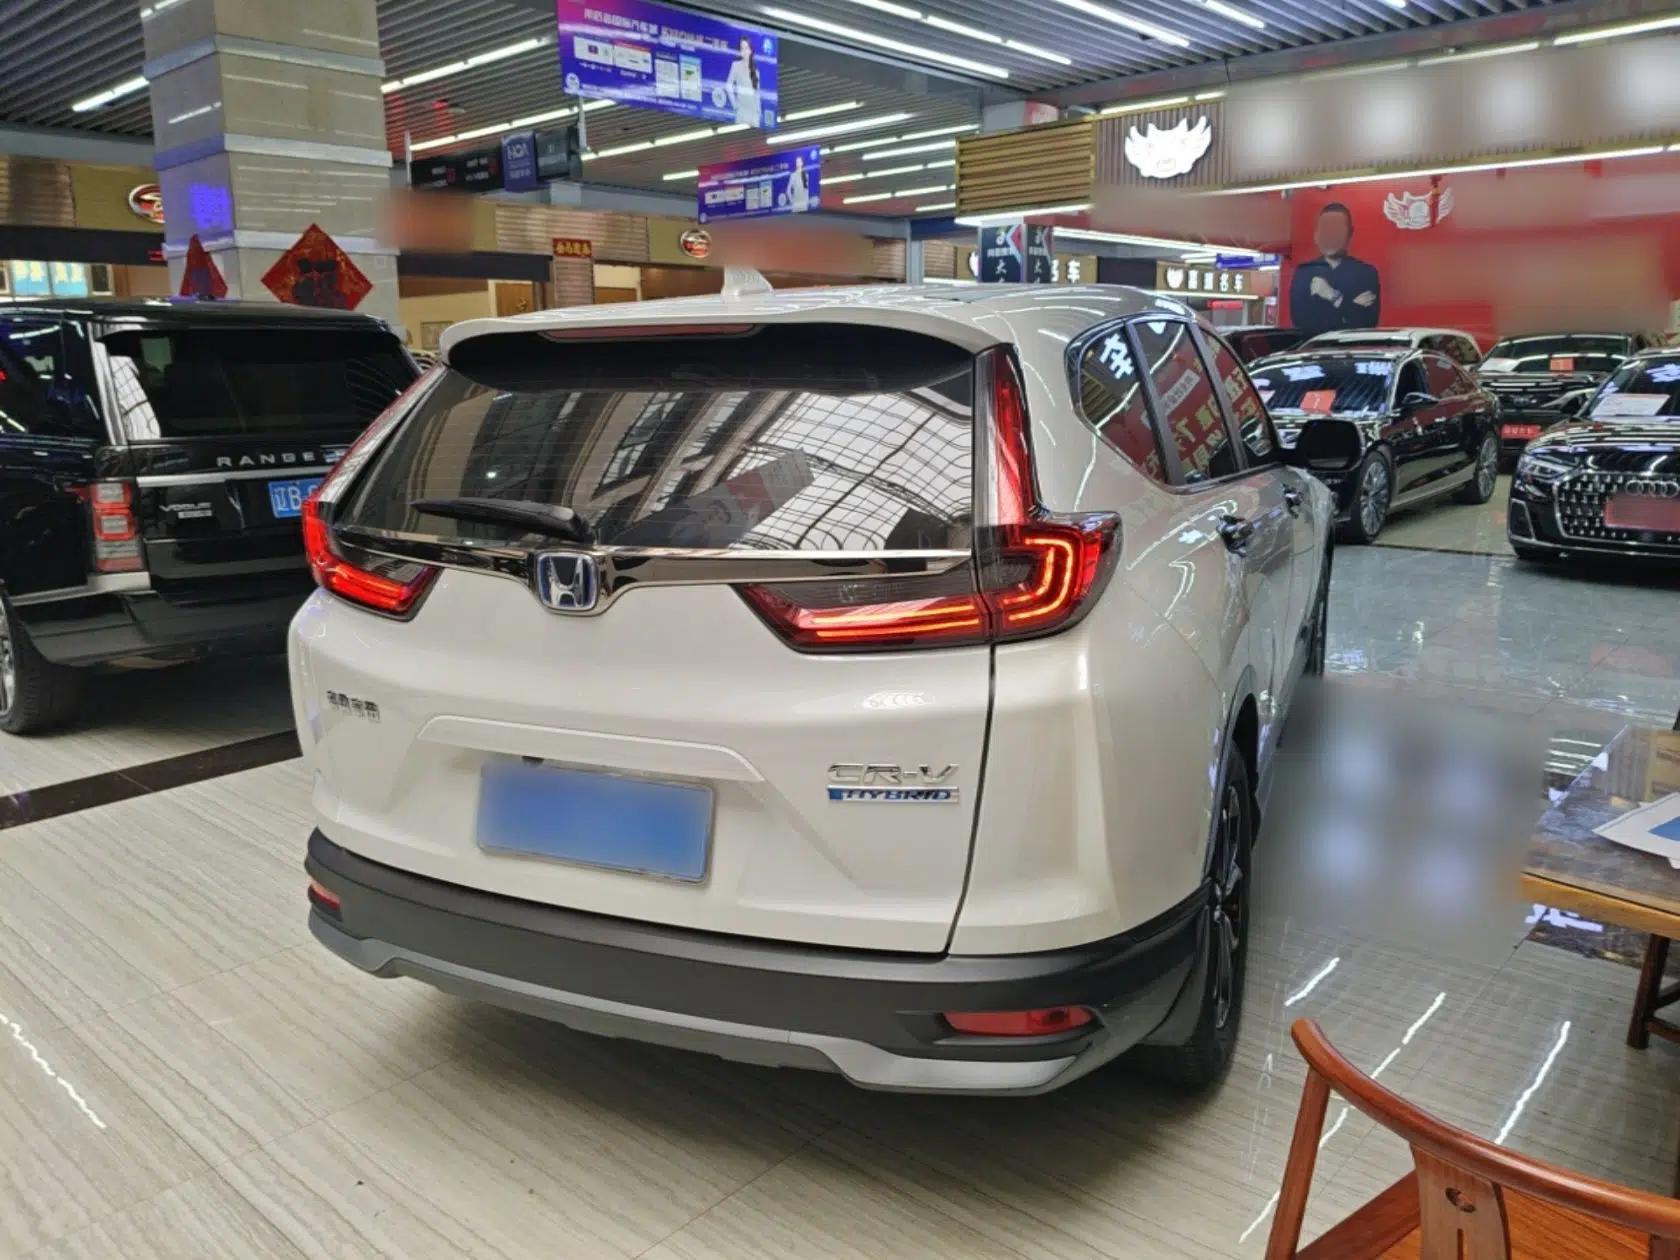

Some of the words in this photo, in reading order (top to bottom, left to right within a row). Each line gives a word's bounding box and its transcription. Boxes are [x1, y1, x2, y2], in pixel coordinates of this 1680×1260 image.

[216, 451, 316, 467] RANGE
[827, 762, 960, 785] CR-V
[842, 788, 953, 802] HYBRID
